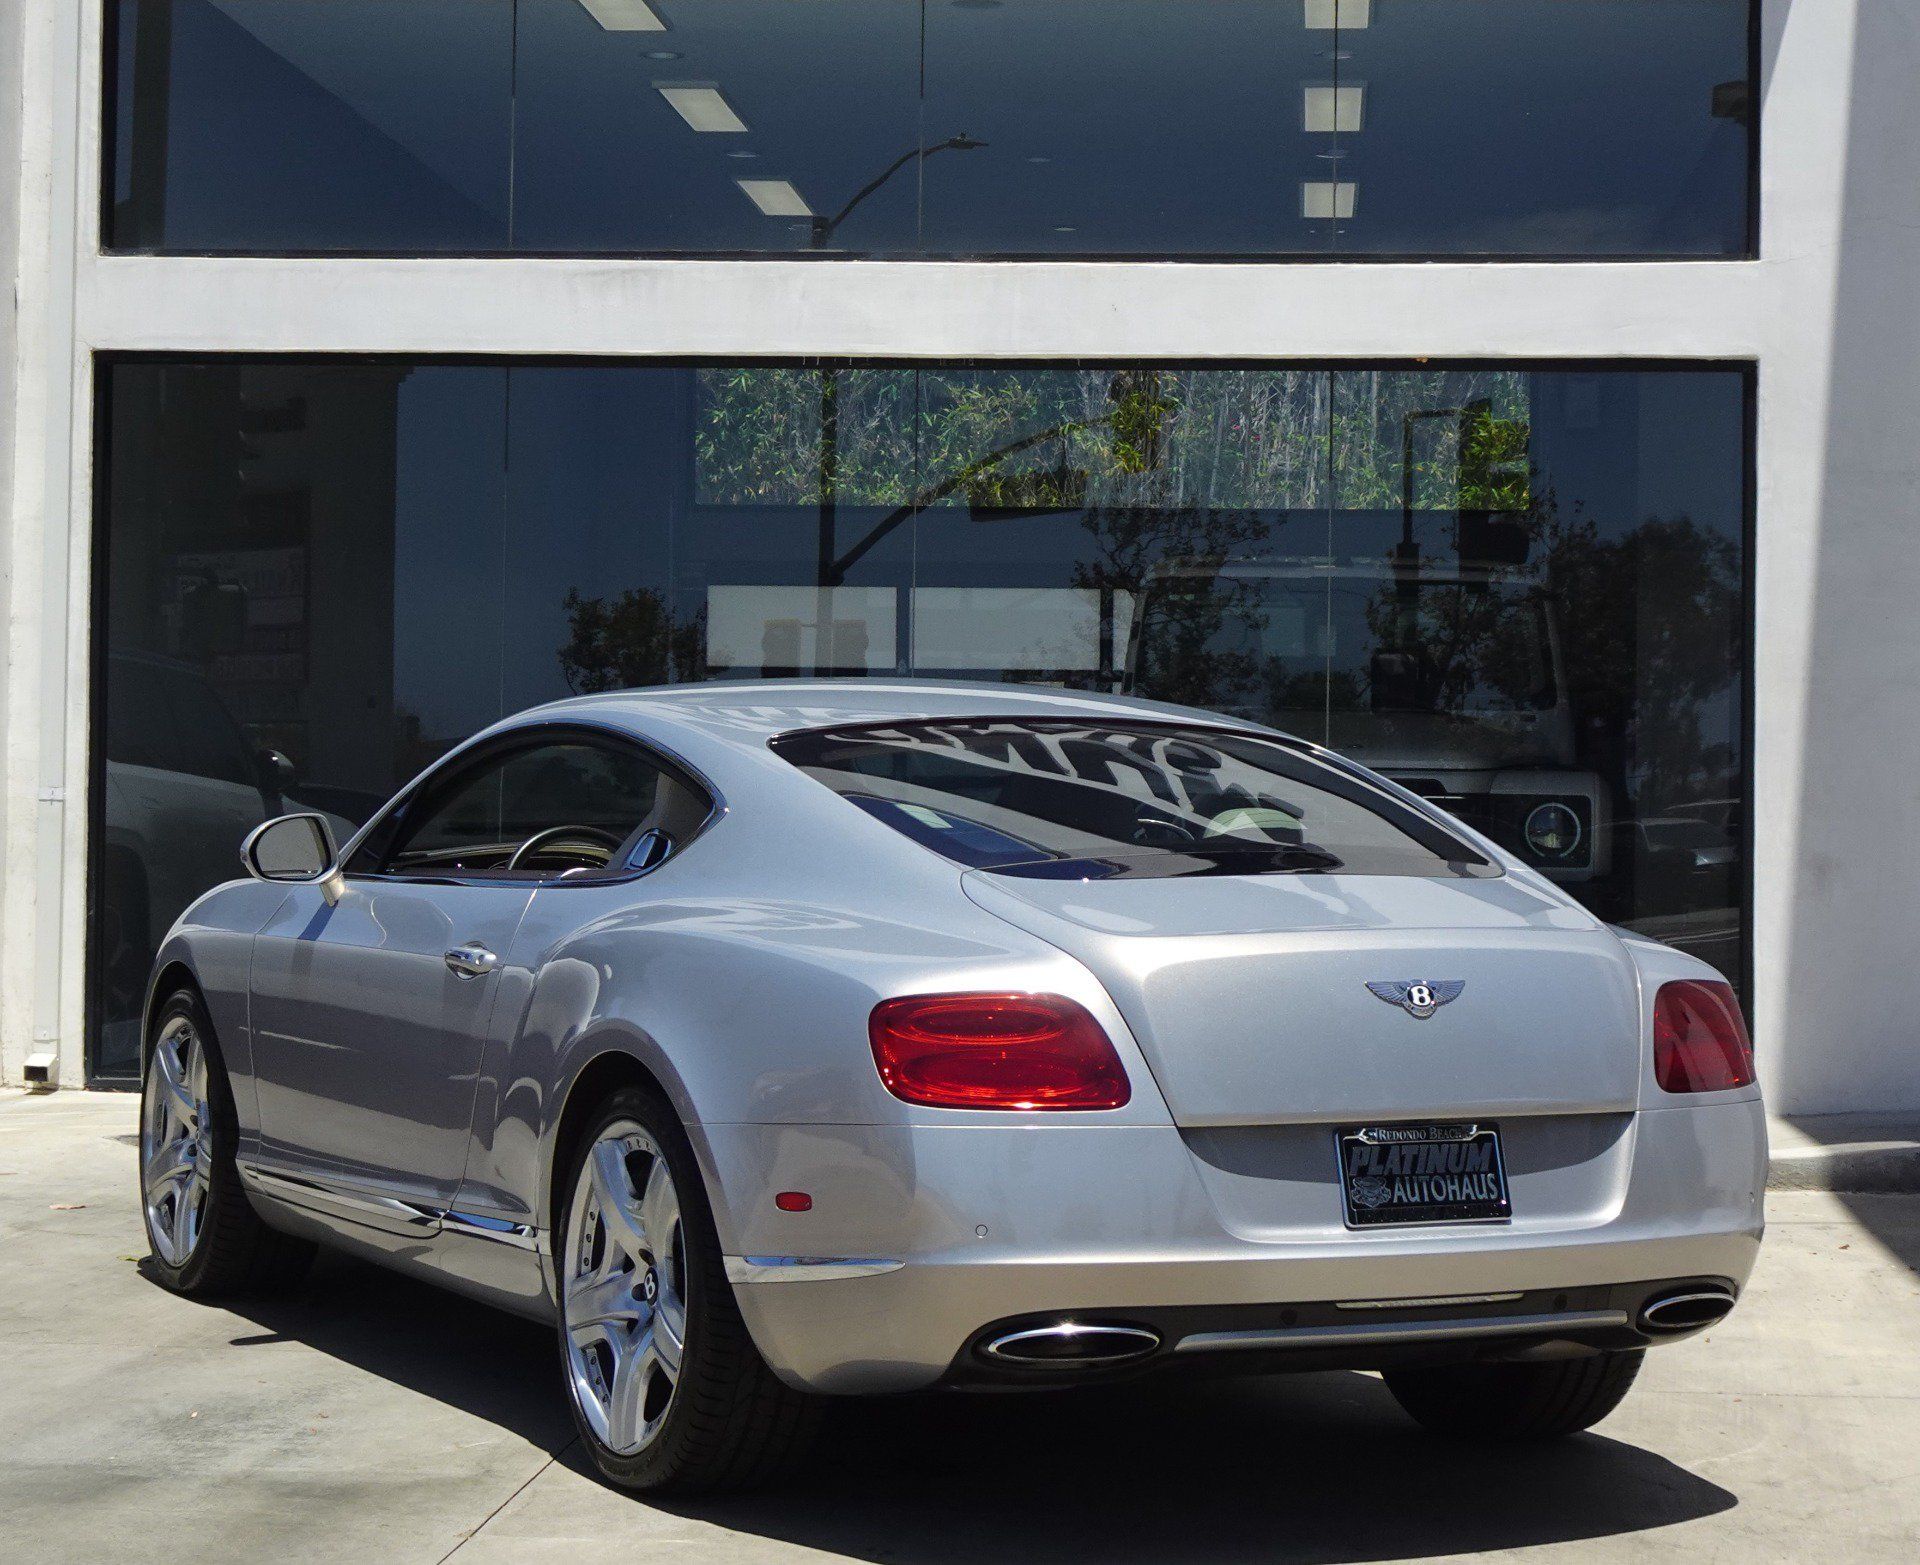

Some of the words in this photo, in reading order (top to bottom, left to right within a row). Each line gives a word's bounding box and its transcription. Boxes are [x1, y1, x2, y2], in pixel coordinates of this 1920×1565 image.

[1411, 985, 1431, 1006] B
[1378, 1128, 1427, 1141] REDONDO
[1350, 1142, 1492, 1175] PLATINUM
[1393, 1173, 1499, 1204] AUTOHAUS
